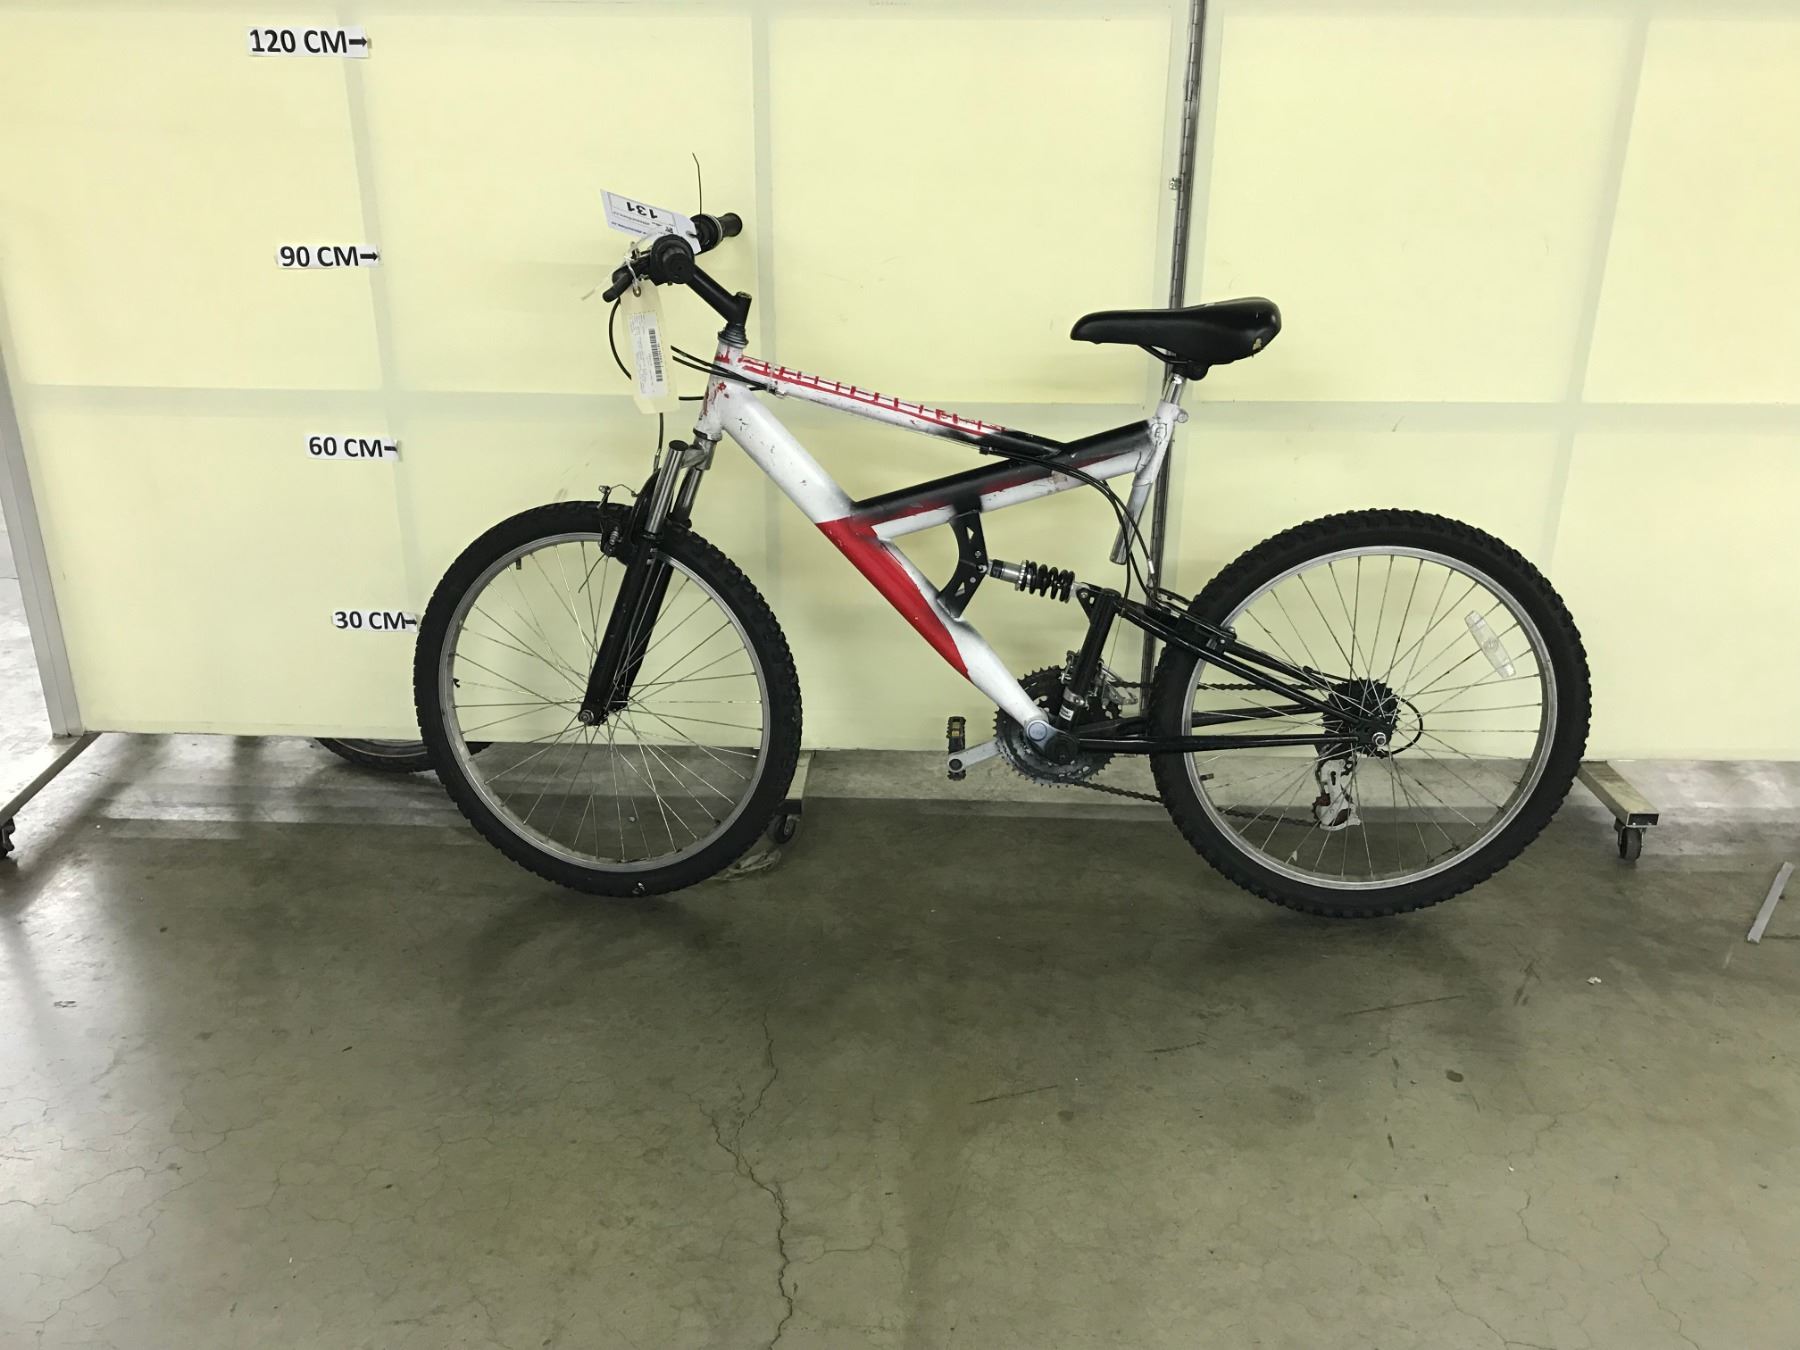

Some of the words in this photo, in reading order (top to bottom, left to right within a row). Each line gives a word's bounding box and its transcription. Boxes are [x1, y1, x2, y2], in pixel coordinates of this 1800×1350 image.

[249, 29, 296, 53] 120
[303, 30, 347, 53] CM
[626, 201, 658, 219] 131
[280, 246, 310, 267] 90
[317, 246, 359, 267] CM
[309, 436, 337, 456] 60
[344, 438, 383, 457] CM
[334, 611, 362, 629] 30
[368, 611, 406, 629] CM
